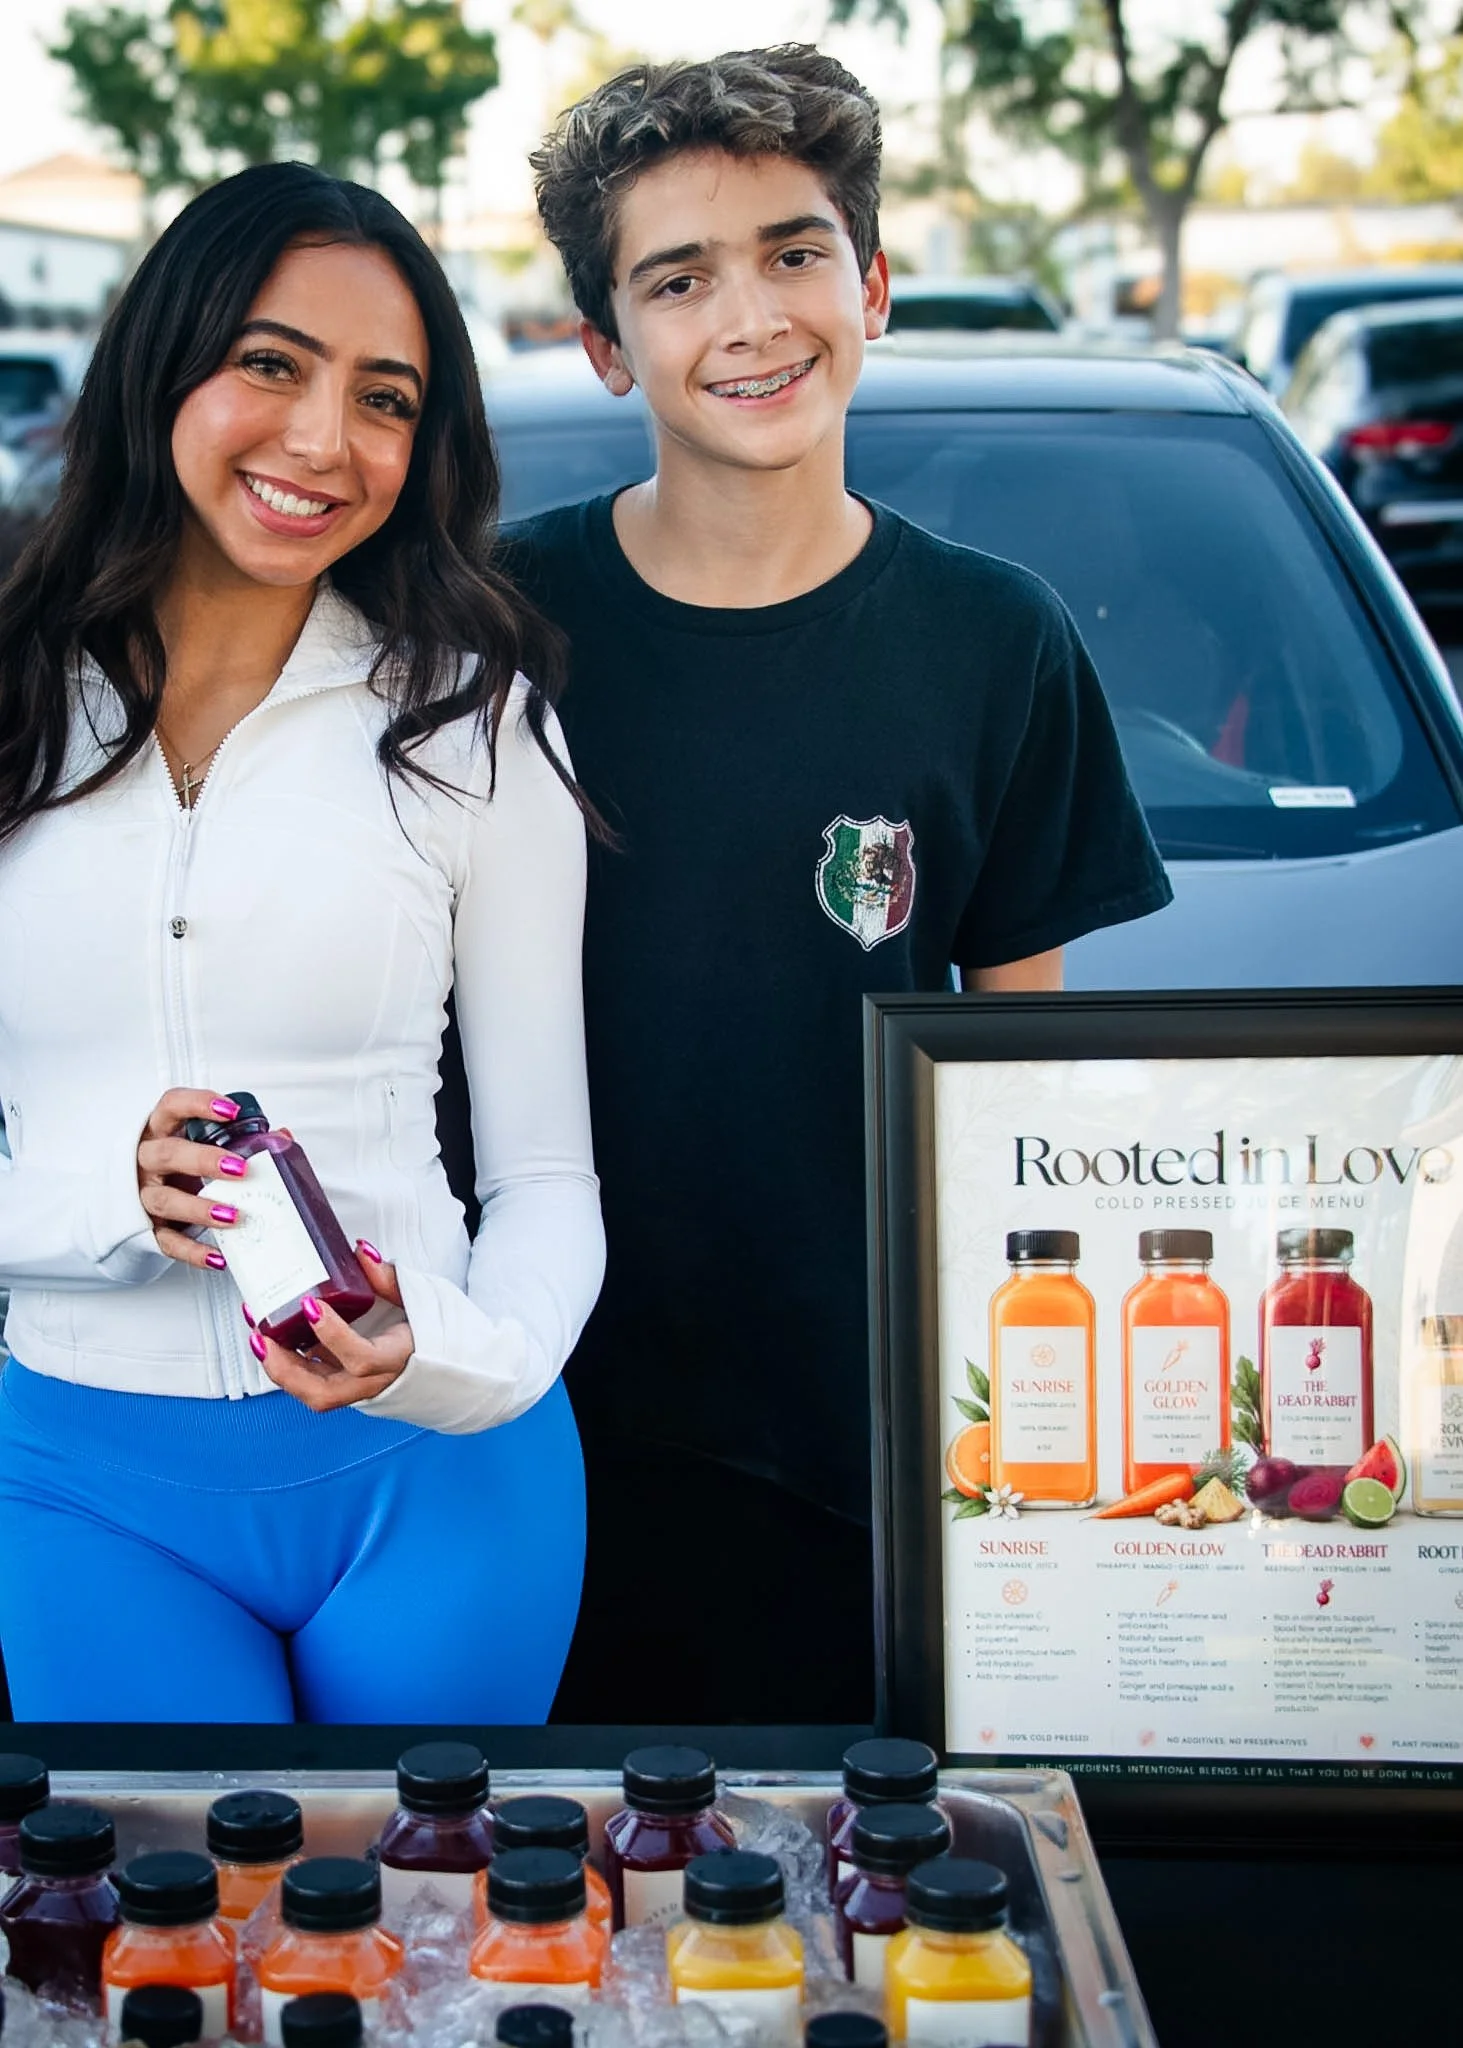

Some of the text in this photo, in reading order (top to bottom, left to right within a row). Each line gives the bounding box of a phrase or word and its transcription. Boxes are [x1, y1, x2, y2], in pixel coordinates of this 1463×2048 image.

[1014, 1129, 1453, 1186] Rooted in Love
[1095, 1196, 1144, 1209] COLD
[1154, 1196, 1236, 1209] PRESSED
[1310, 1195, 1365, 1208] MENU
[1011, 1379, 1074, 1393] SUNRISE
[1144, 1379, 1208, 1393] GOLDEN
[1303, 1380, 1327, 1393] THE
[1152, 1395, 1198, 1410] GLOW
[1278, 1394, 1357, 1408] DEAD RABBIT
[979, 1540, 1048, 1555] SUNRISE
[1114, 1541, 1226, 1556] GOLDEN GLOW
[1295, 1543, 1334, 1558] DEAD
[1336, 1544, 1388, 1558] RABBIT
[1418, 1545, 1460, 1559] ROOT
[1007, 1734, 1089, 1742] 100% COLD PRESSED
[1167, 1736, 1179, 1744] NO
[1229, 1737, 1241, 1745] NO
[1127, 1764, 1195, 1775] INTENTIONAL
[1244, 1767, 1263, 1776] LET
[1266, 1767, 1284, 1776] ALL
[1289, 1767, 1314, 1777] THAT
[1318, 1768, 1340, 1778] YOU
[1343, 1768, 1359, 1778] DO
[1362, 1769, 1375, 1778] BE
[1378, 1769, 1407, 1779] DONE
[1411, 1770, 1423, 1779] IN
